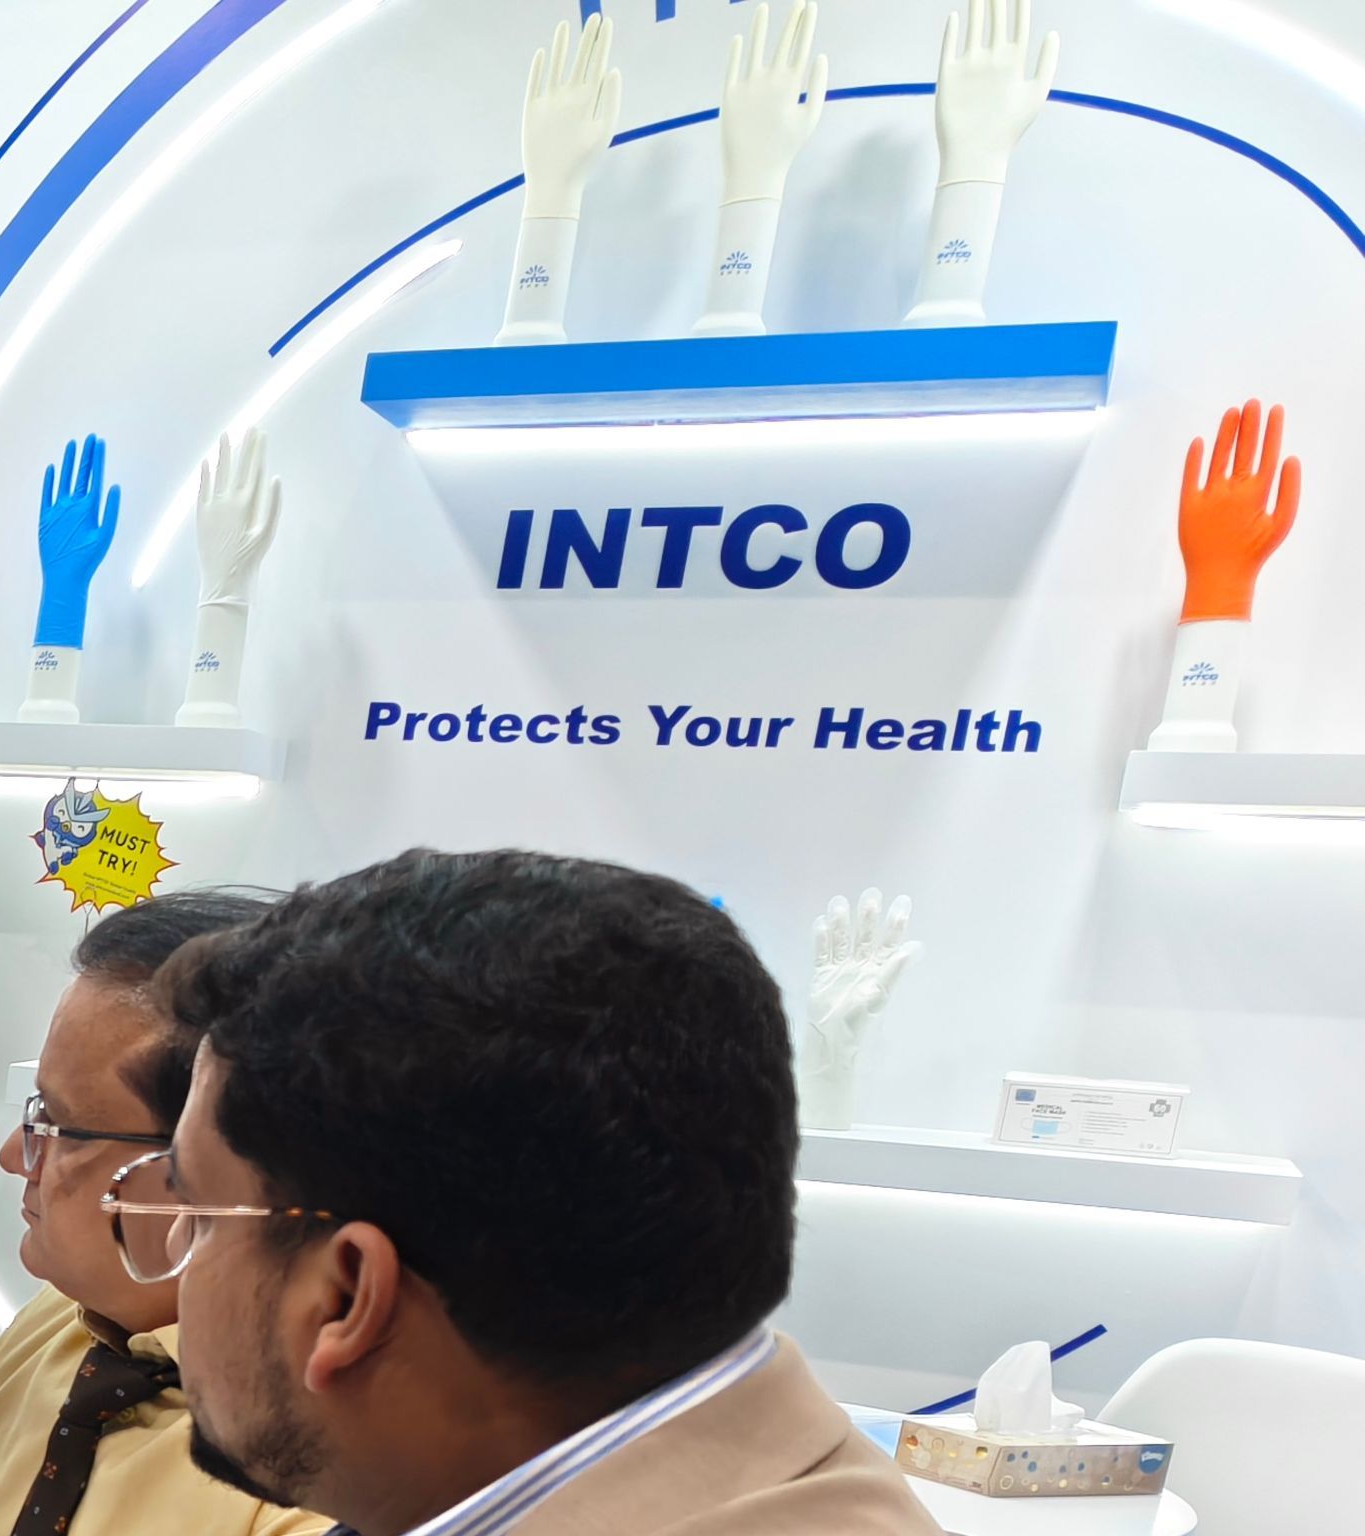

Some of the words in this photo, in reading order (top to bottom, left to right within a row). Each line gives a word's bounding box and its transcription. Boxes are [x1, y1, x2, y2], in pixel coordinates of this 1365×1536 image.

[496, 502, 911, 590] INTCO
[364, 701, 622, 746] Protects
[647, 704, 794, 748] Your
[813, 706, 1043, 753] Health
[99, 826, 150, 854] MUST
[98, 849, 138, 876] TRY!
